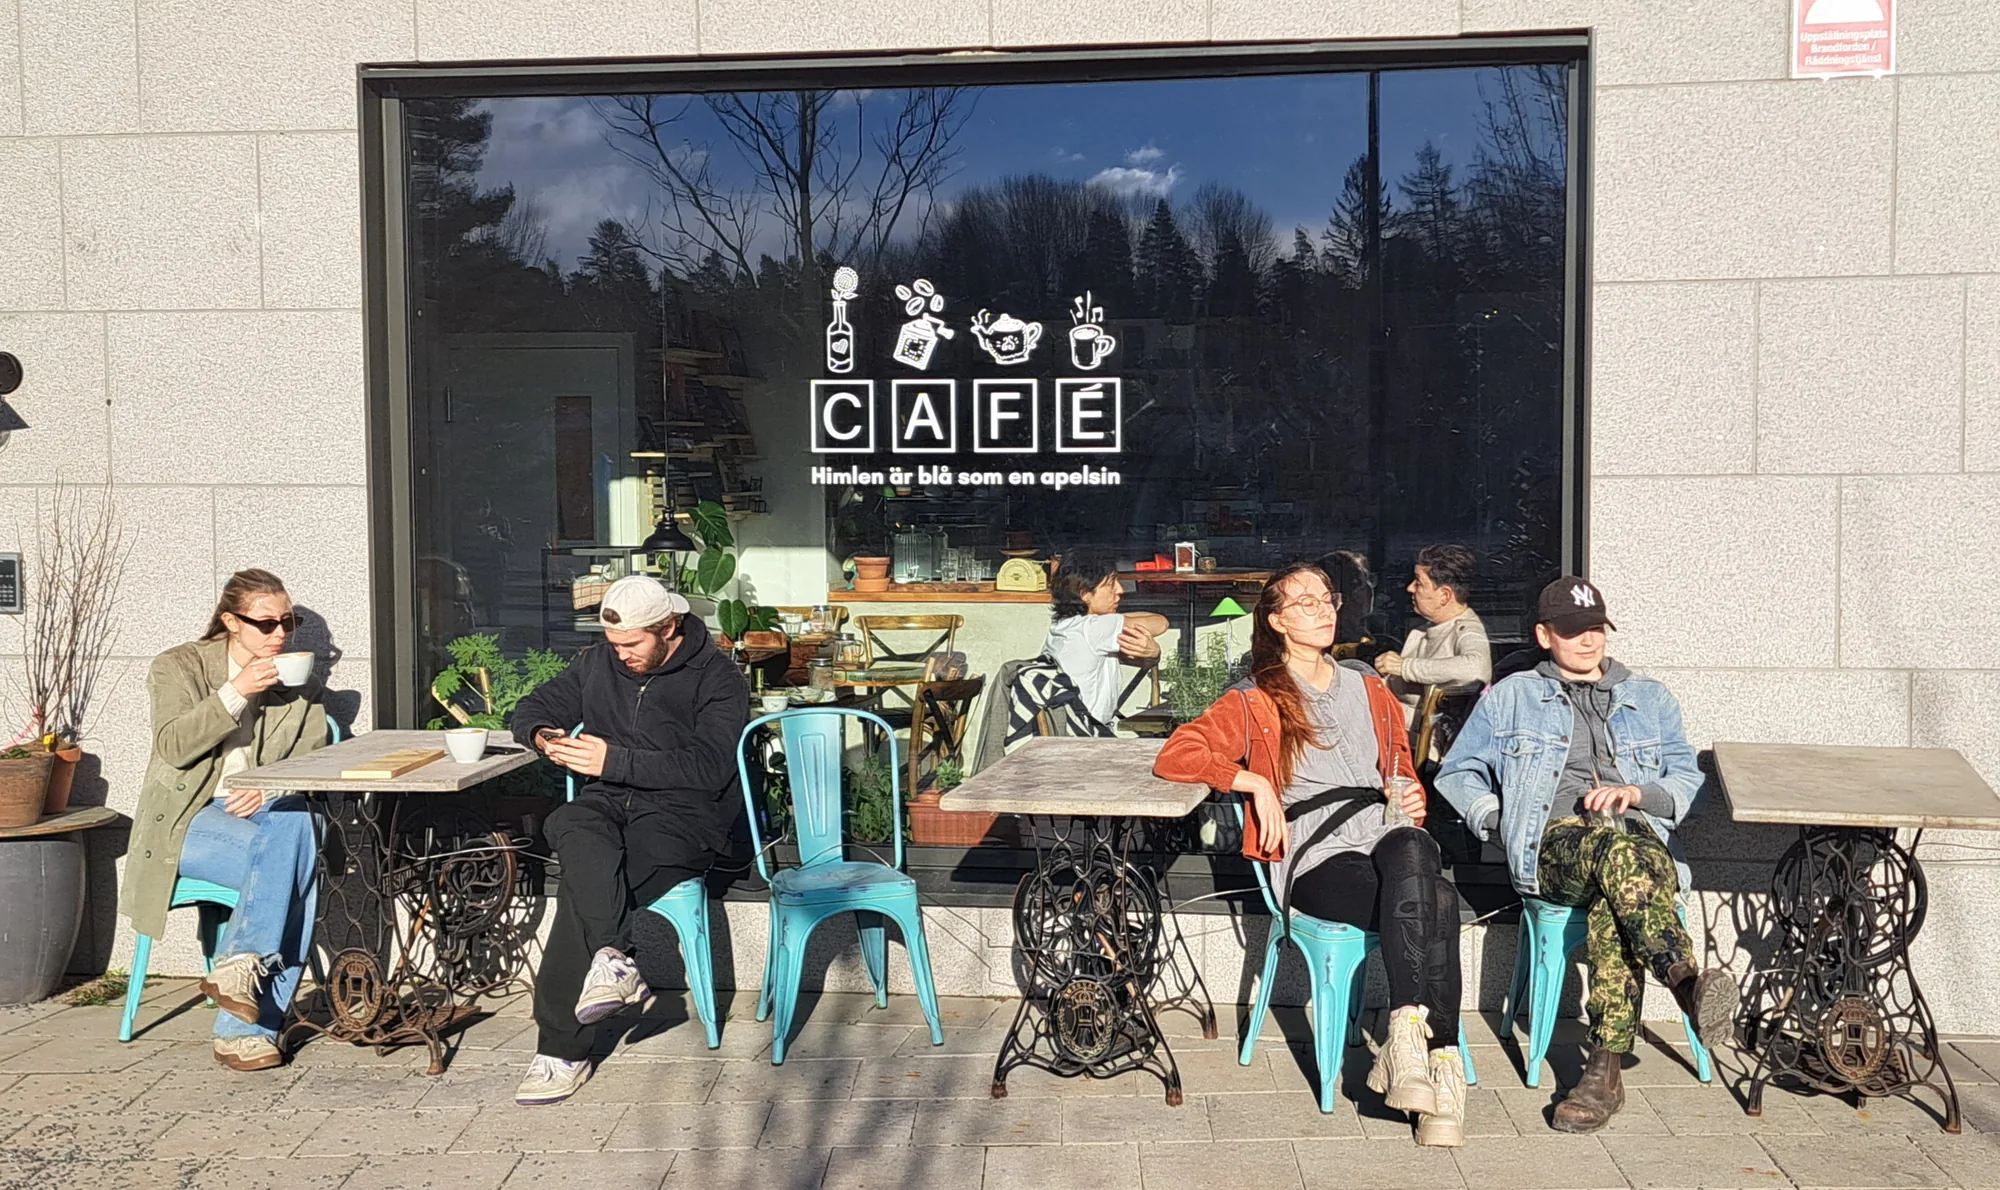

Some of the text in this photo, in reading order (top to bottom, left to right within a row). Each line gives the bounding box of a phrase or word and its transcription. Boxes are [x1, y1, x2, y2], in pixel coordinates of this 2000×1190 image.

[823, 383, 1105, 440] CAFÉ
[811, 465, 1121, 491] Himlen är blå som en apelsin
[1570, 584, 1596, 607] NY
